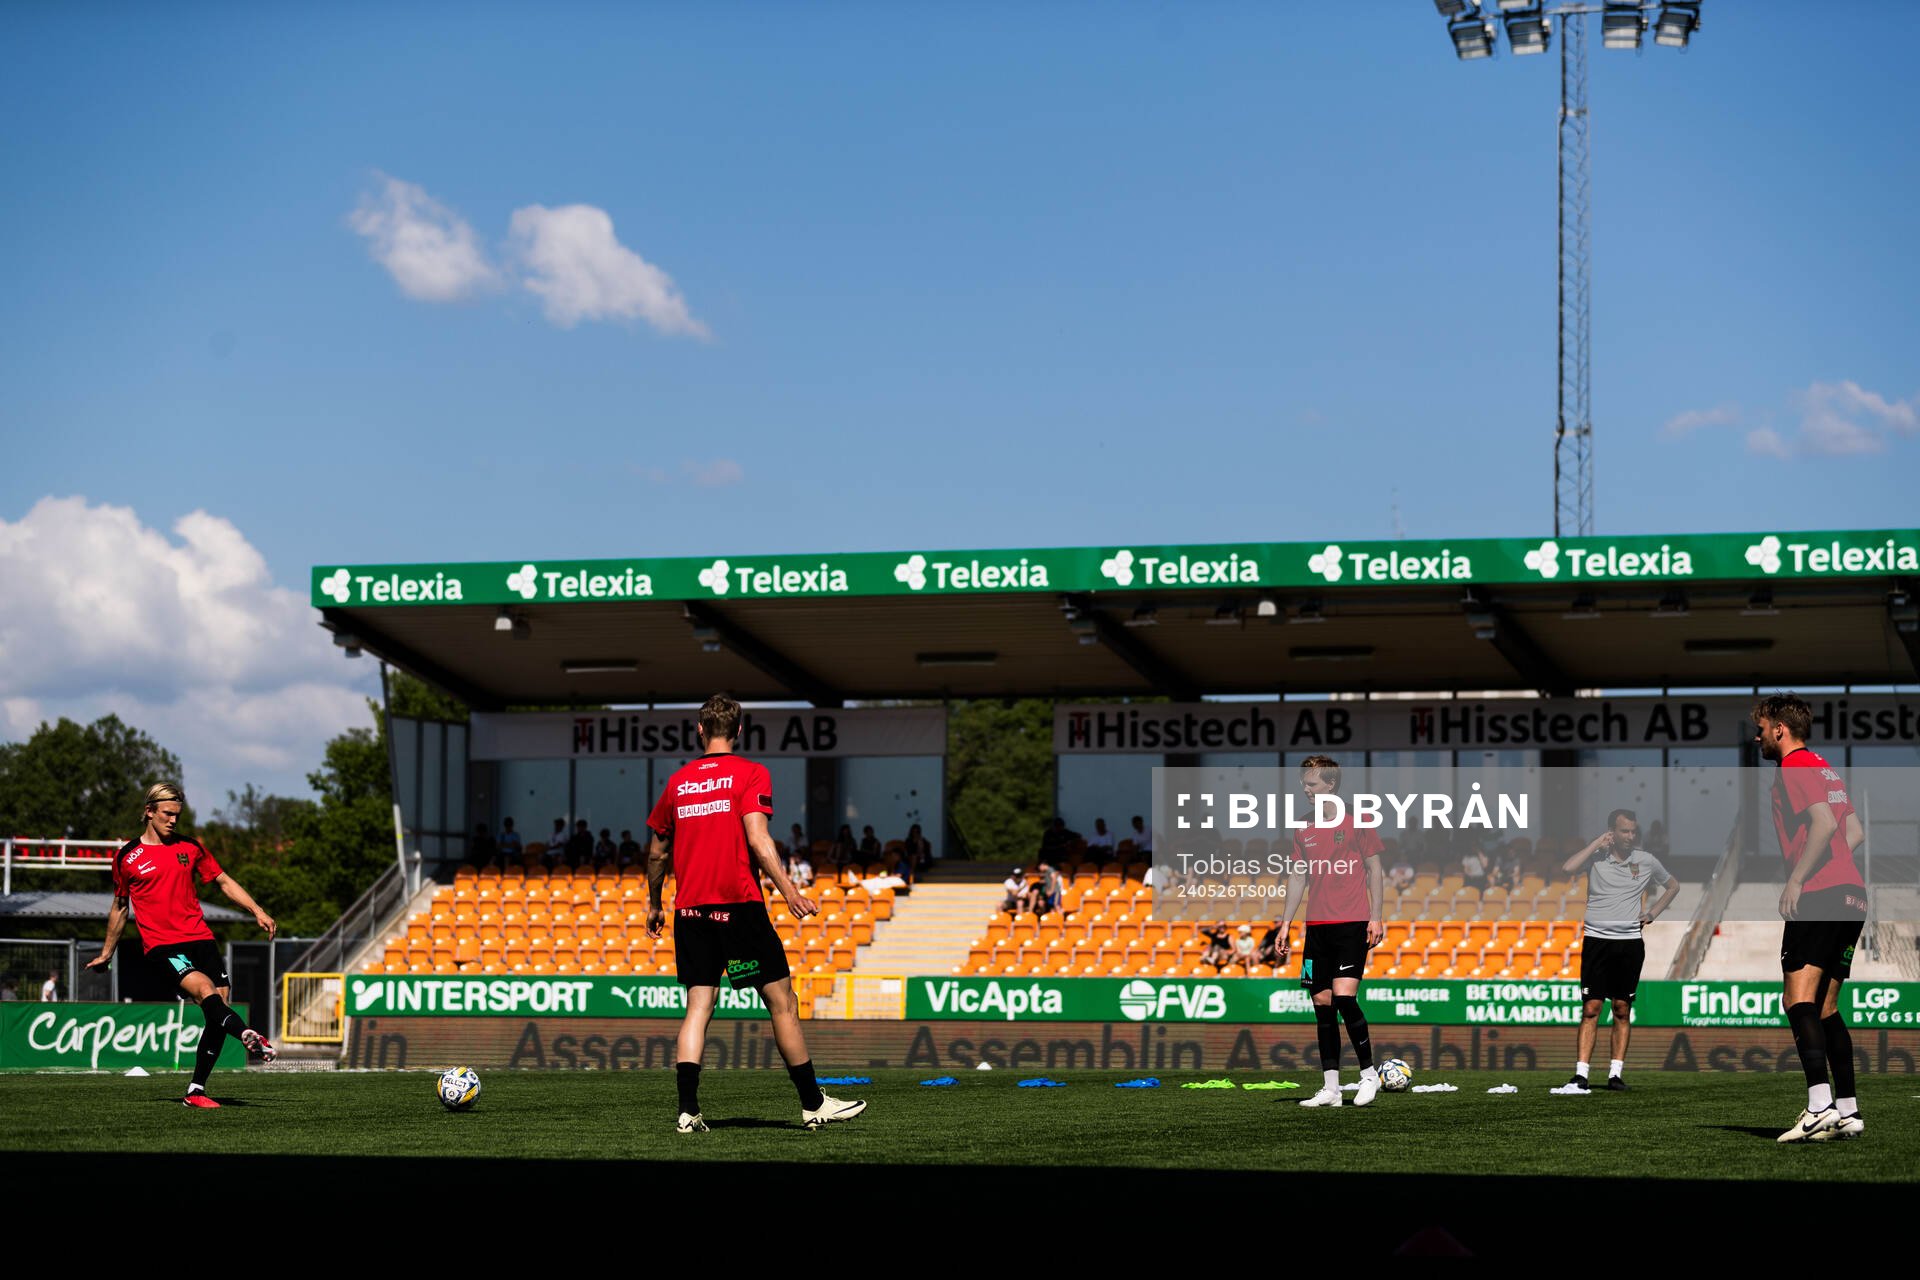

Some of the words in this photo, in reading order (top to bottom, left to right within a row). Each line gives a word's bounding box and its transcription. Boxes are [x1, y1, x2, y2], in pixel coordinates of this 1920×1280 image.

[1139, 553, 1260, 584] Telexia
[1348, 549, 1472, 581] Telexia
[1565, 544, 1693, 577] Telexia
[1787, 539, 1919, 572] Telexia
[355, 572, 463, 602] Telexia
[542, 567, 653, 598] Telexia
[734, 563, 849, 593] Telexia
[931, 558, 1049, 589] Telexia
[600, 714, 766, 752] Hissth
[780, 715, 838, 752] AB
[1097, 707, 1283, 748] Hisstech
[1290, 708, 1352, 746] AB
[1440, 702, 1628, 744] Hisstech
[1644, 703, 1709, 742] AB
[1806, 700, 1920, 740] Hisst
[677, 775, 733, 796] stadium
[677, 800, 731, 819] BAUHAUS
[681, 908, 730, 921] BAUAUS
[386, 980, 594, 1012] INTERSPORT
[637, 986, 689, 1009] FOREV
[719, 986, 768, 1009] FAST
[925, 981, 1063, 1021] VicApta
[1156, 984, 1227, 1019] FVB
[1366, 988, 1450, 1002] MELLINGER
[1395, 1003, 1420, 1016] BIL
[1852, 988, 1900, 1009] LGP
[1466, 1003, 1583, 1023] MÄLARDALE
[28, 1009, 203, 1070] Carpente
[905, 1022, 1202, 1070] Assemblin
[1663, 1030, 1916, 1074] Asseb
